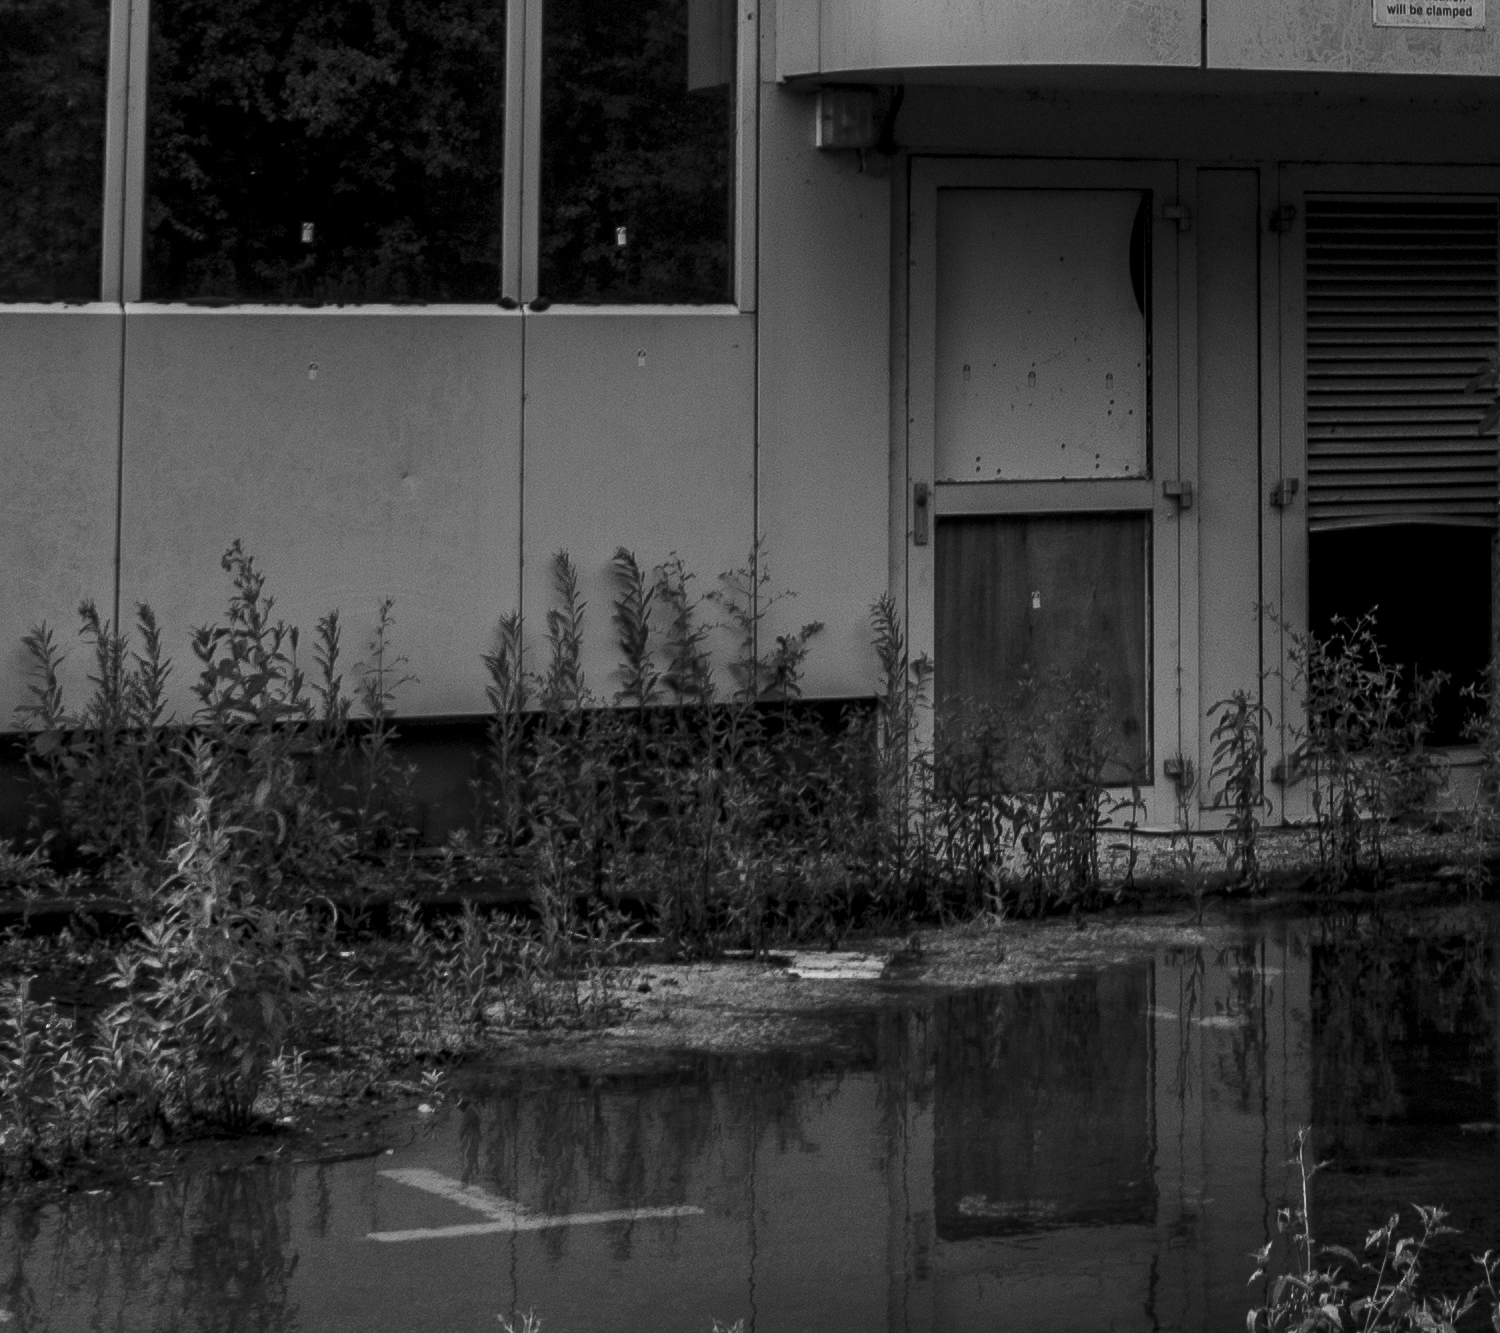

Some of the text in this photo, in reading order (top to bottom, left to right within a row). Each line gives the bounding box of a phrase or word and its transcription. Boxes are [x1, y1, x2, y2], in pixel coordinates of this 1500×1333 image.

[1387, 3, 1473, 19] will be clamped
